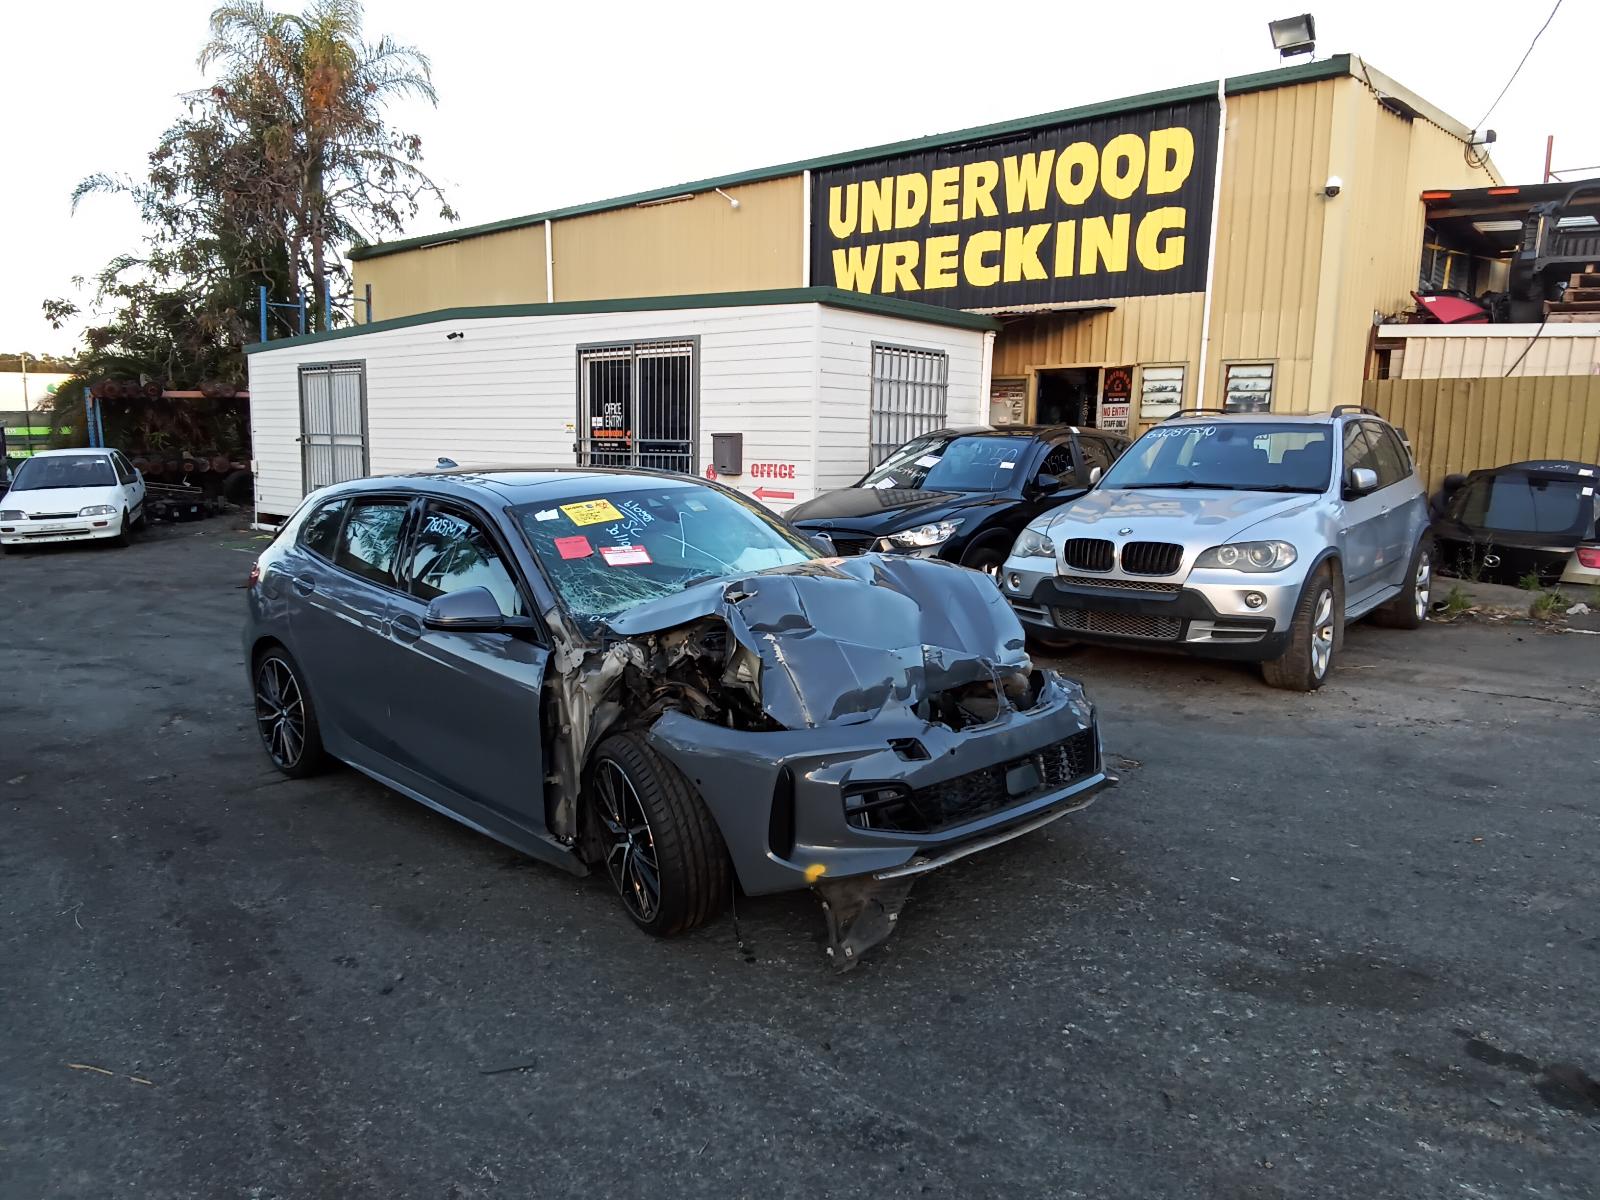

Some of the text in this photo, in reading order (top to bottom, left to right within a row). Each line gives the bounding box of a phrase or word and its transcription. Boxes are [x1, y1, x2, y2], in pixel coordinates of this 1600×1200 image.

[828, 127, 1195, 240] UNDERWOOD
[832, 206, 1187, 294] WRECKING
[605, 403, 622, 415] OFFICE
[1103, 406, 1129, 416] NO ENTRY
[1103, 419, 1127, 428] STAFF ONLY
[751, 463, 796, 479] OFFICE
